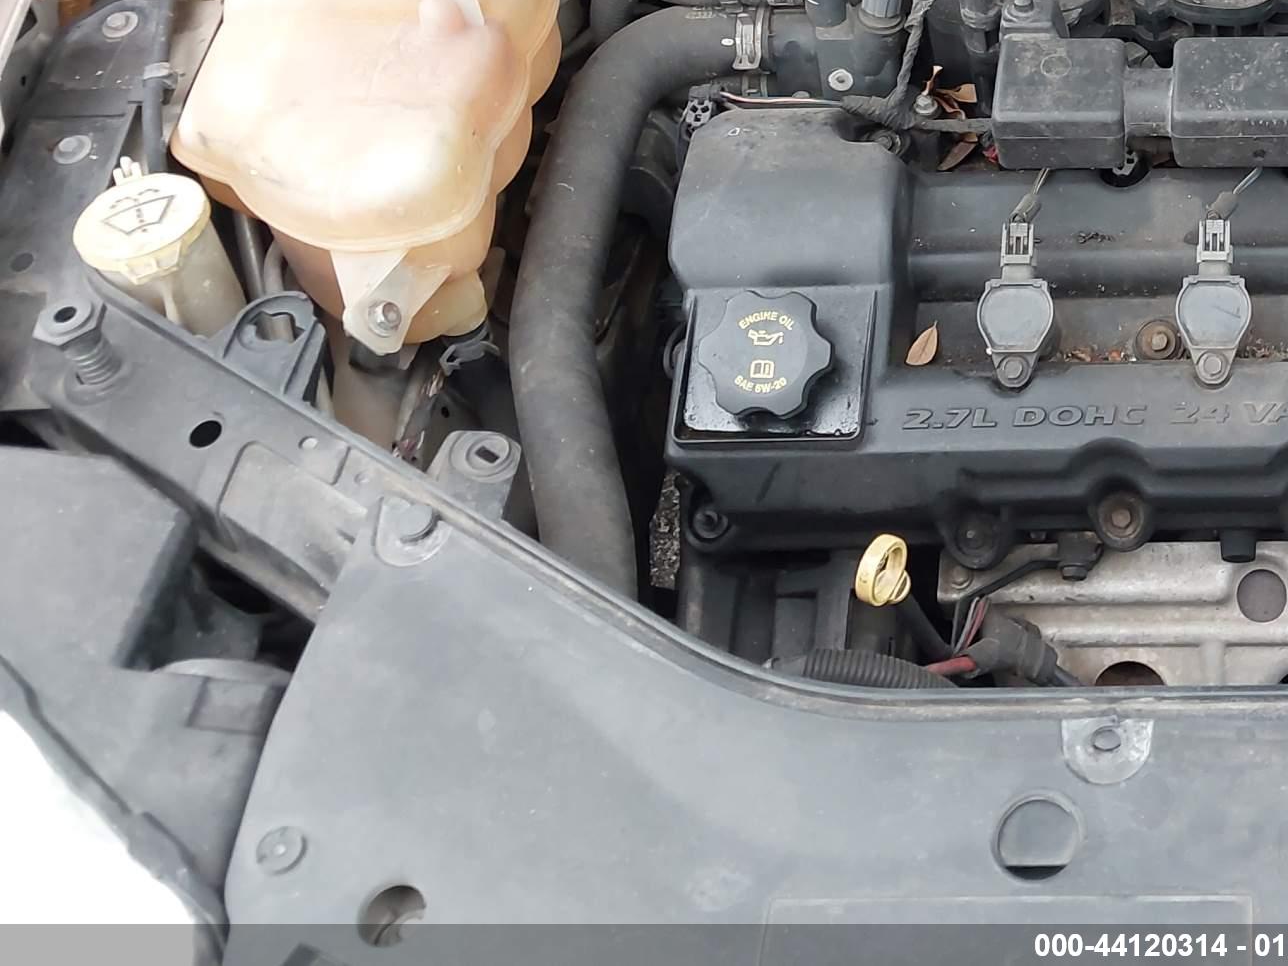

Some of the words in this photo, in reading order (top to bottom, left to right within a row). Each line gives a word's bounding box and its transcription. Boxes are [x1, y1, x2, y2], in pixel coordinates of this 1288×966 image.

[739, 311, 778, 329] ENGINE
[779, 314, 796, 330] OIL
[735, 376, 754, 391] SAE
[902, 408, 997, 429] 2.7L
[1013, 405, 1147, 427] DOHC
[1171, 402, 1231, 424] 24
